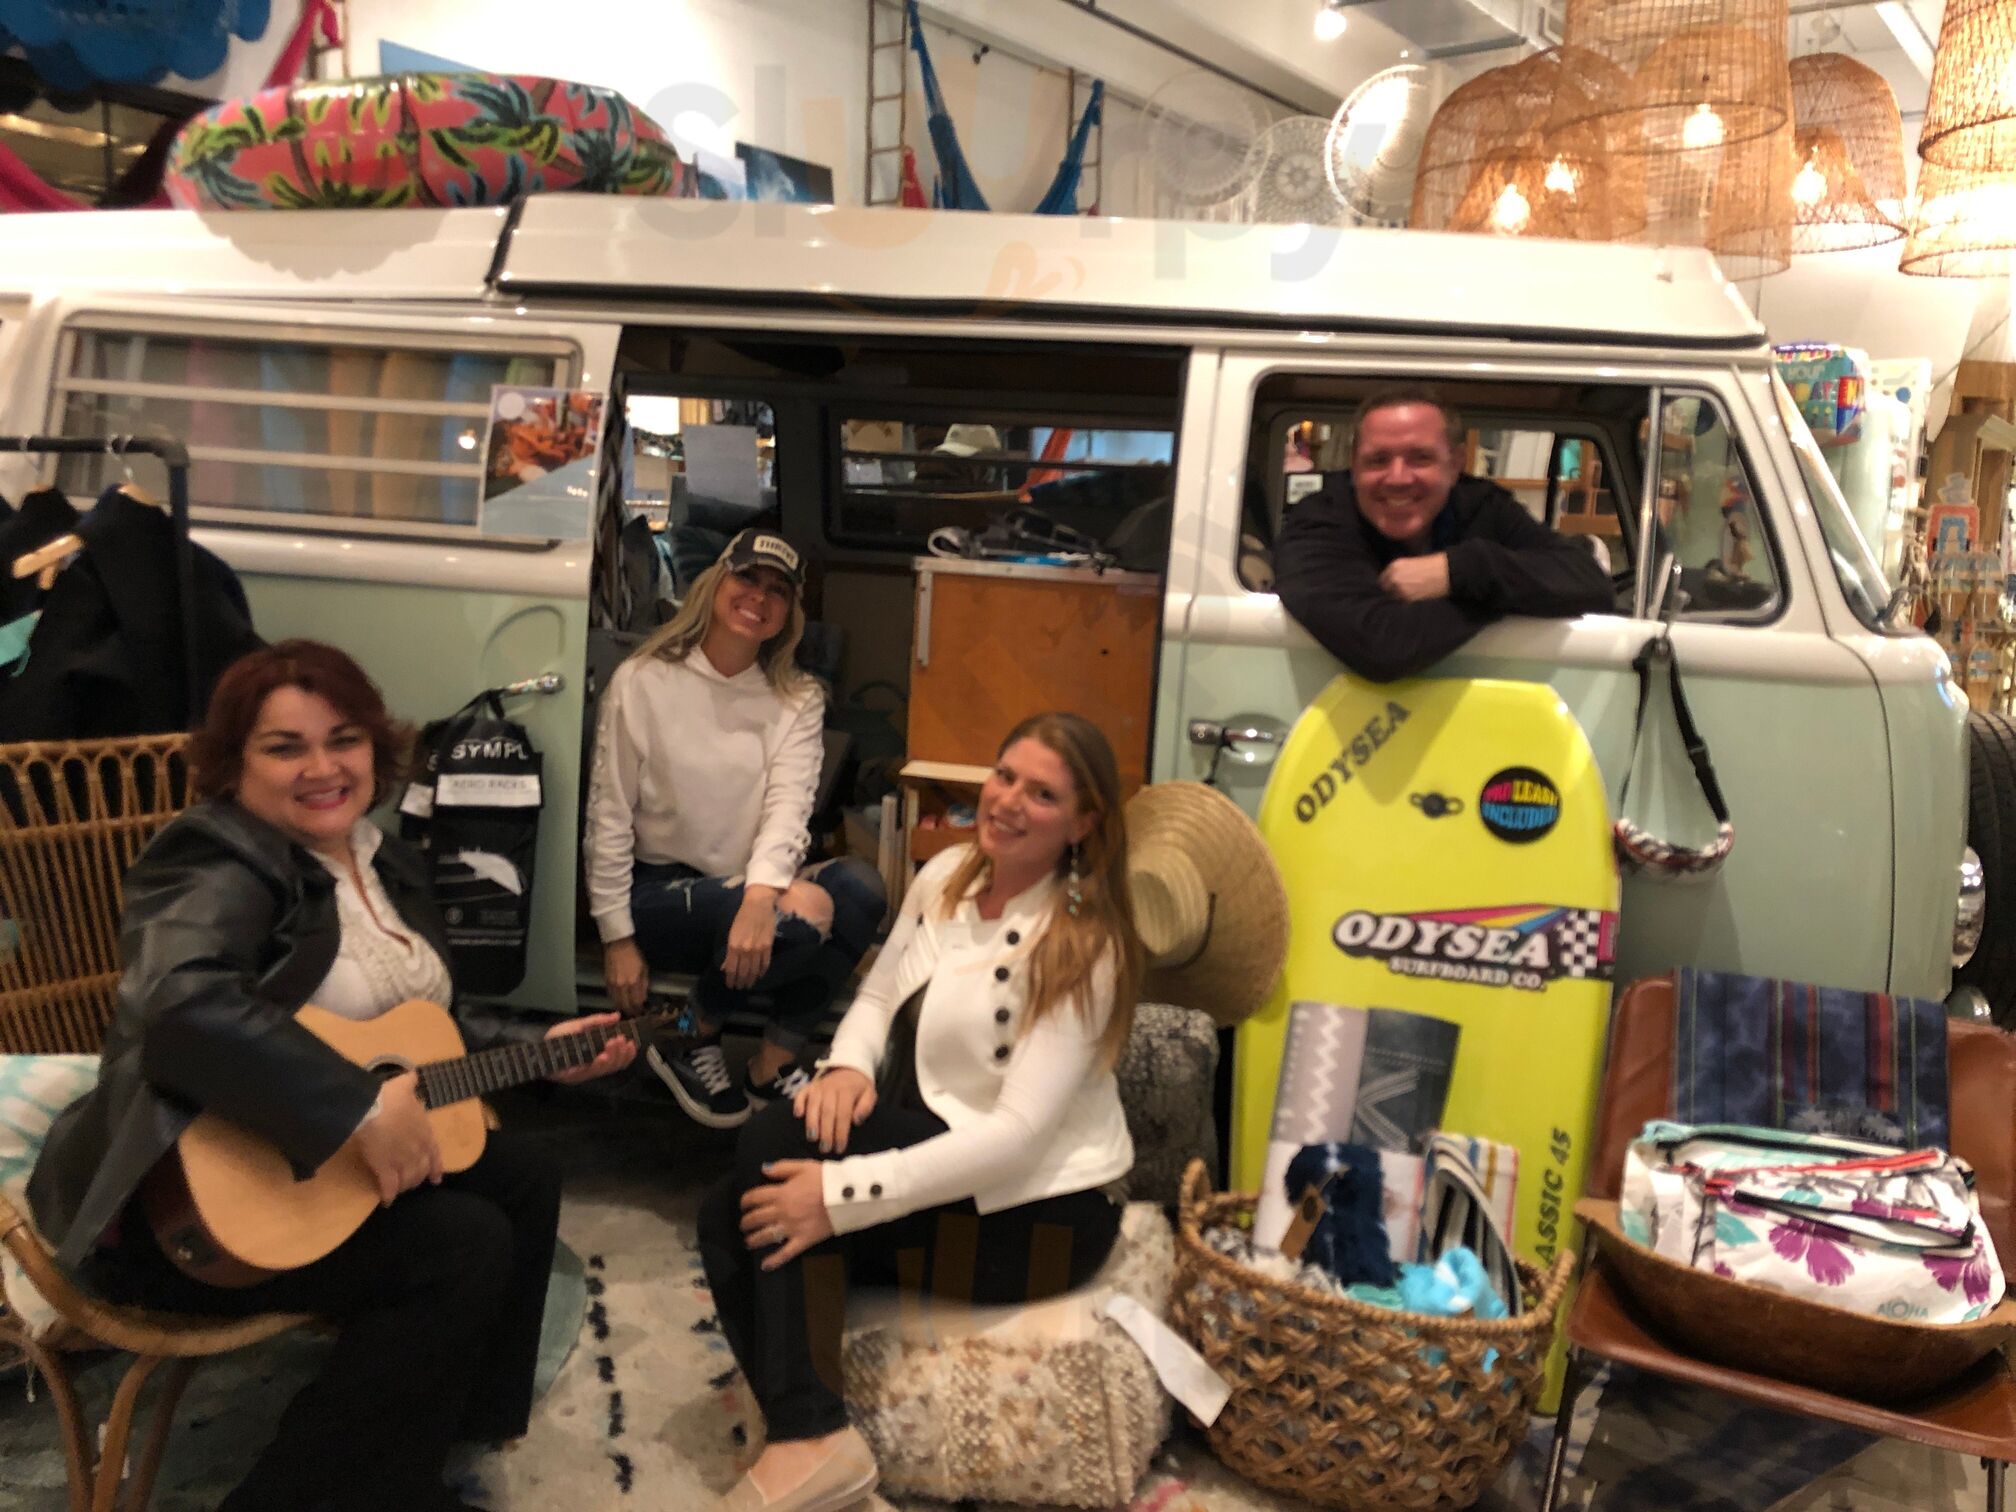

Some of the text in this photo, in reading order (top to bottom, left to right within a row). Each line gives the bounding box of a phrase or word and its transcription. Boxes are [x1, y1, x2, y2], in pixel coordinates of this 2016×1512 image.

[1296, 701, 1412, 823] ODYSEA
[1333, 911, 1550, 969] ODYSEA
[1388, 956, 1548, 992] SURFBOARD CO.
[1551, 1127, 1571, 1166] 45
